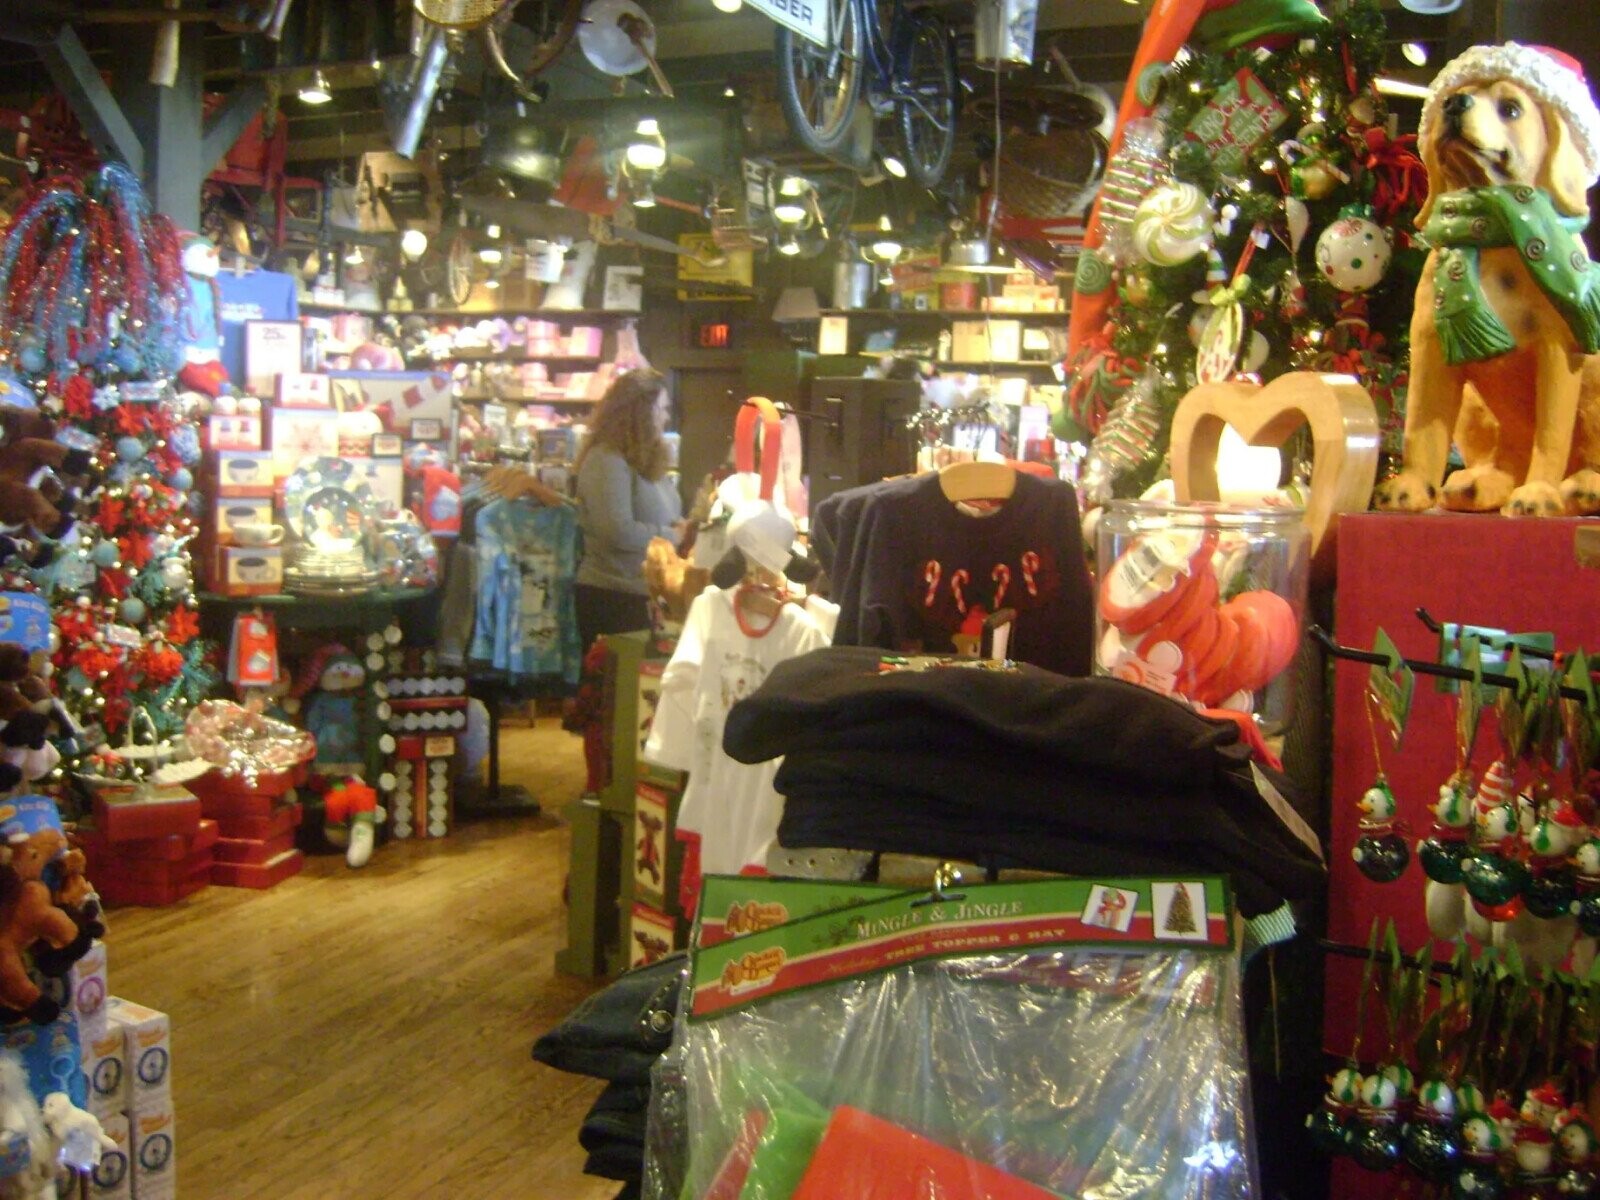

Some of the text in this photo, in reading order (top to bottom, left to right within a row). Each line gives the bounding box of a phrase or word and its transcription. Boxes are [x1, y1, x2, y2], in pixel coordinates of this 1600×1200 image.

[770, 0, 813, 26] BER
[929, 905, 947, 922] &
[932, 935, 999, 949] TOPPER
